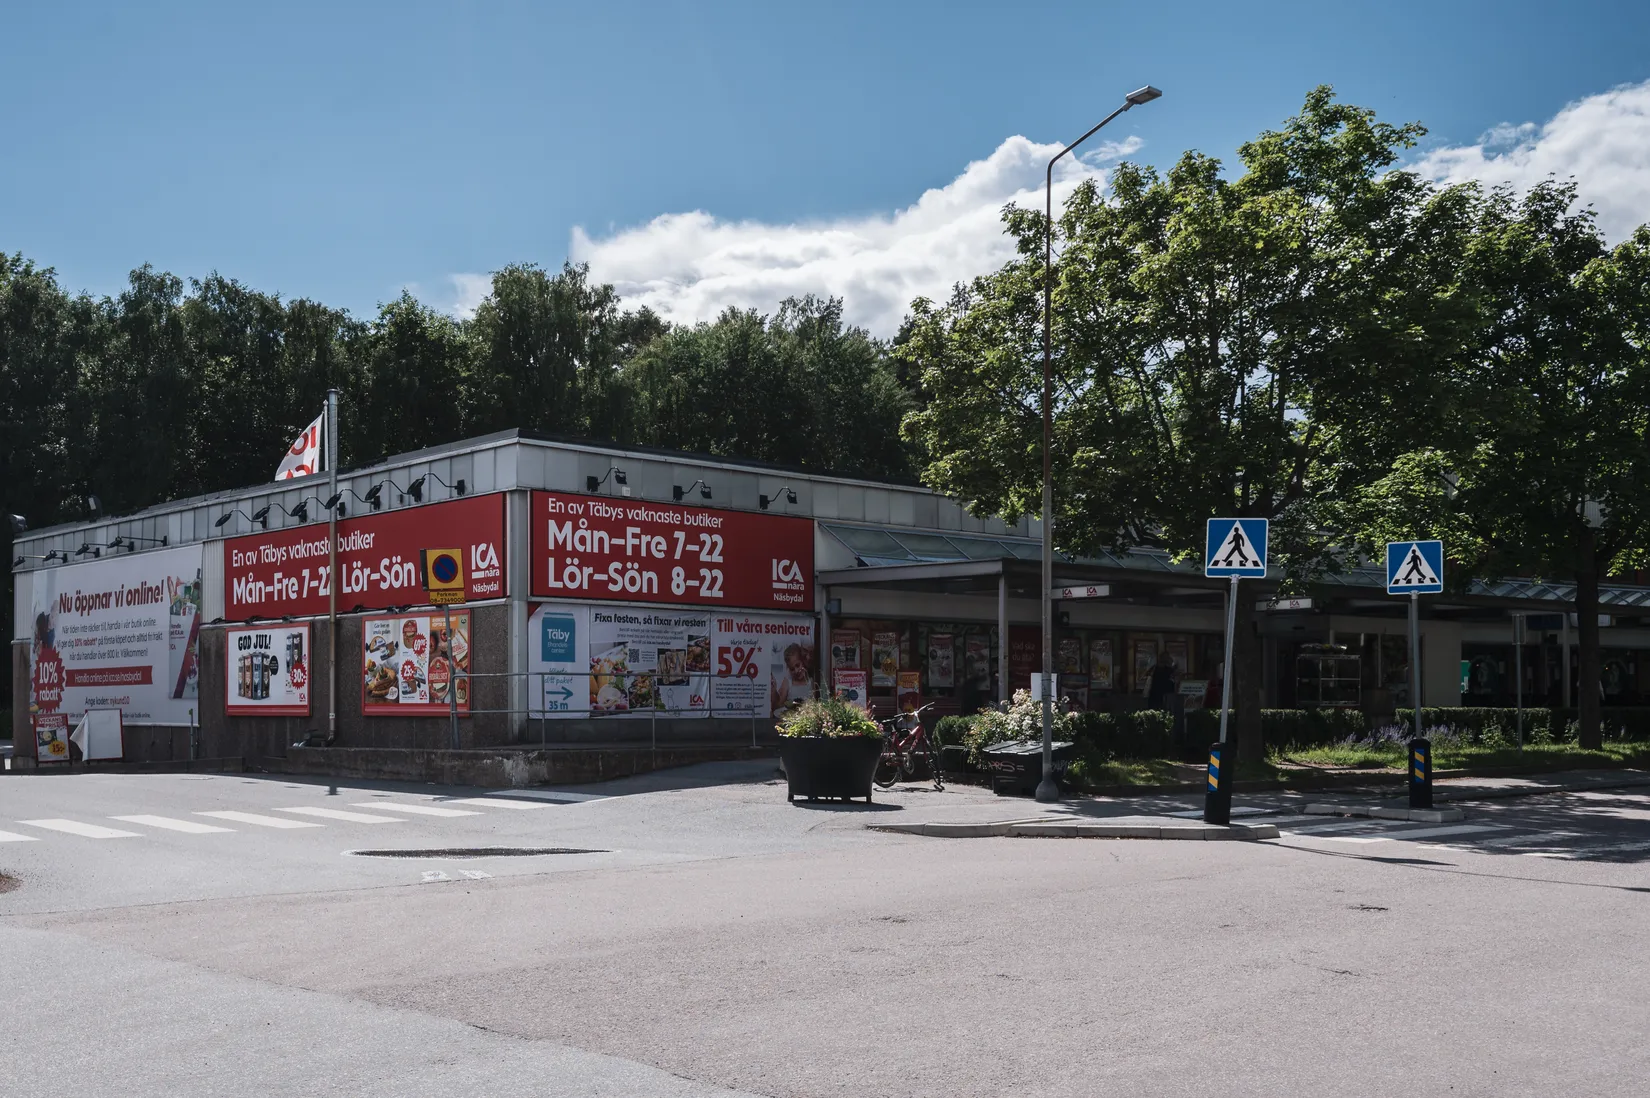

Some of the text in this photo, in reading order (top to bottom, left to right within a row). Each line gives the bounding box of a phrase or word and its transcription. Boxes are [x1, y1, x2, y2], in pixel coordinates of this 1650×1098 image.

[549, 498, 723, 529] En av Täbys vaknaste butiker
[232, 530, 375, 567] En av Täbys vaknast butiker
[471, 542, 500, 570] ICA
[772, 558, 804, 582] ICA
[472, 581, 499, 594] Näsbydal
[1062, 588, 1073, 596] ICA
[1087, 586, 1097, 594] ICA
[59, 579, 164, 617] Nu öppnar vi online!
[773, 593, 804, 604] Näsbydal
[594, 612, 706, 628] Fixa festen, så fixar vi resten
[717, 618, 811, 636] Till våra seniorer
[238, 634, 272, 651] GOD JUL!
[547, 628, 570, 642] Täby
[39, 662, 58, 684] 10%
[549, 700, 568, 710] 35 m
[690, 694, 705, 703] ICA
